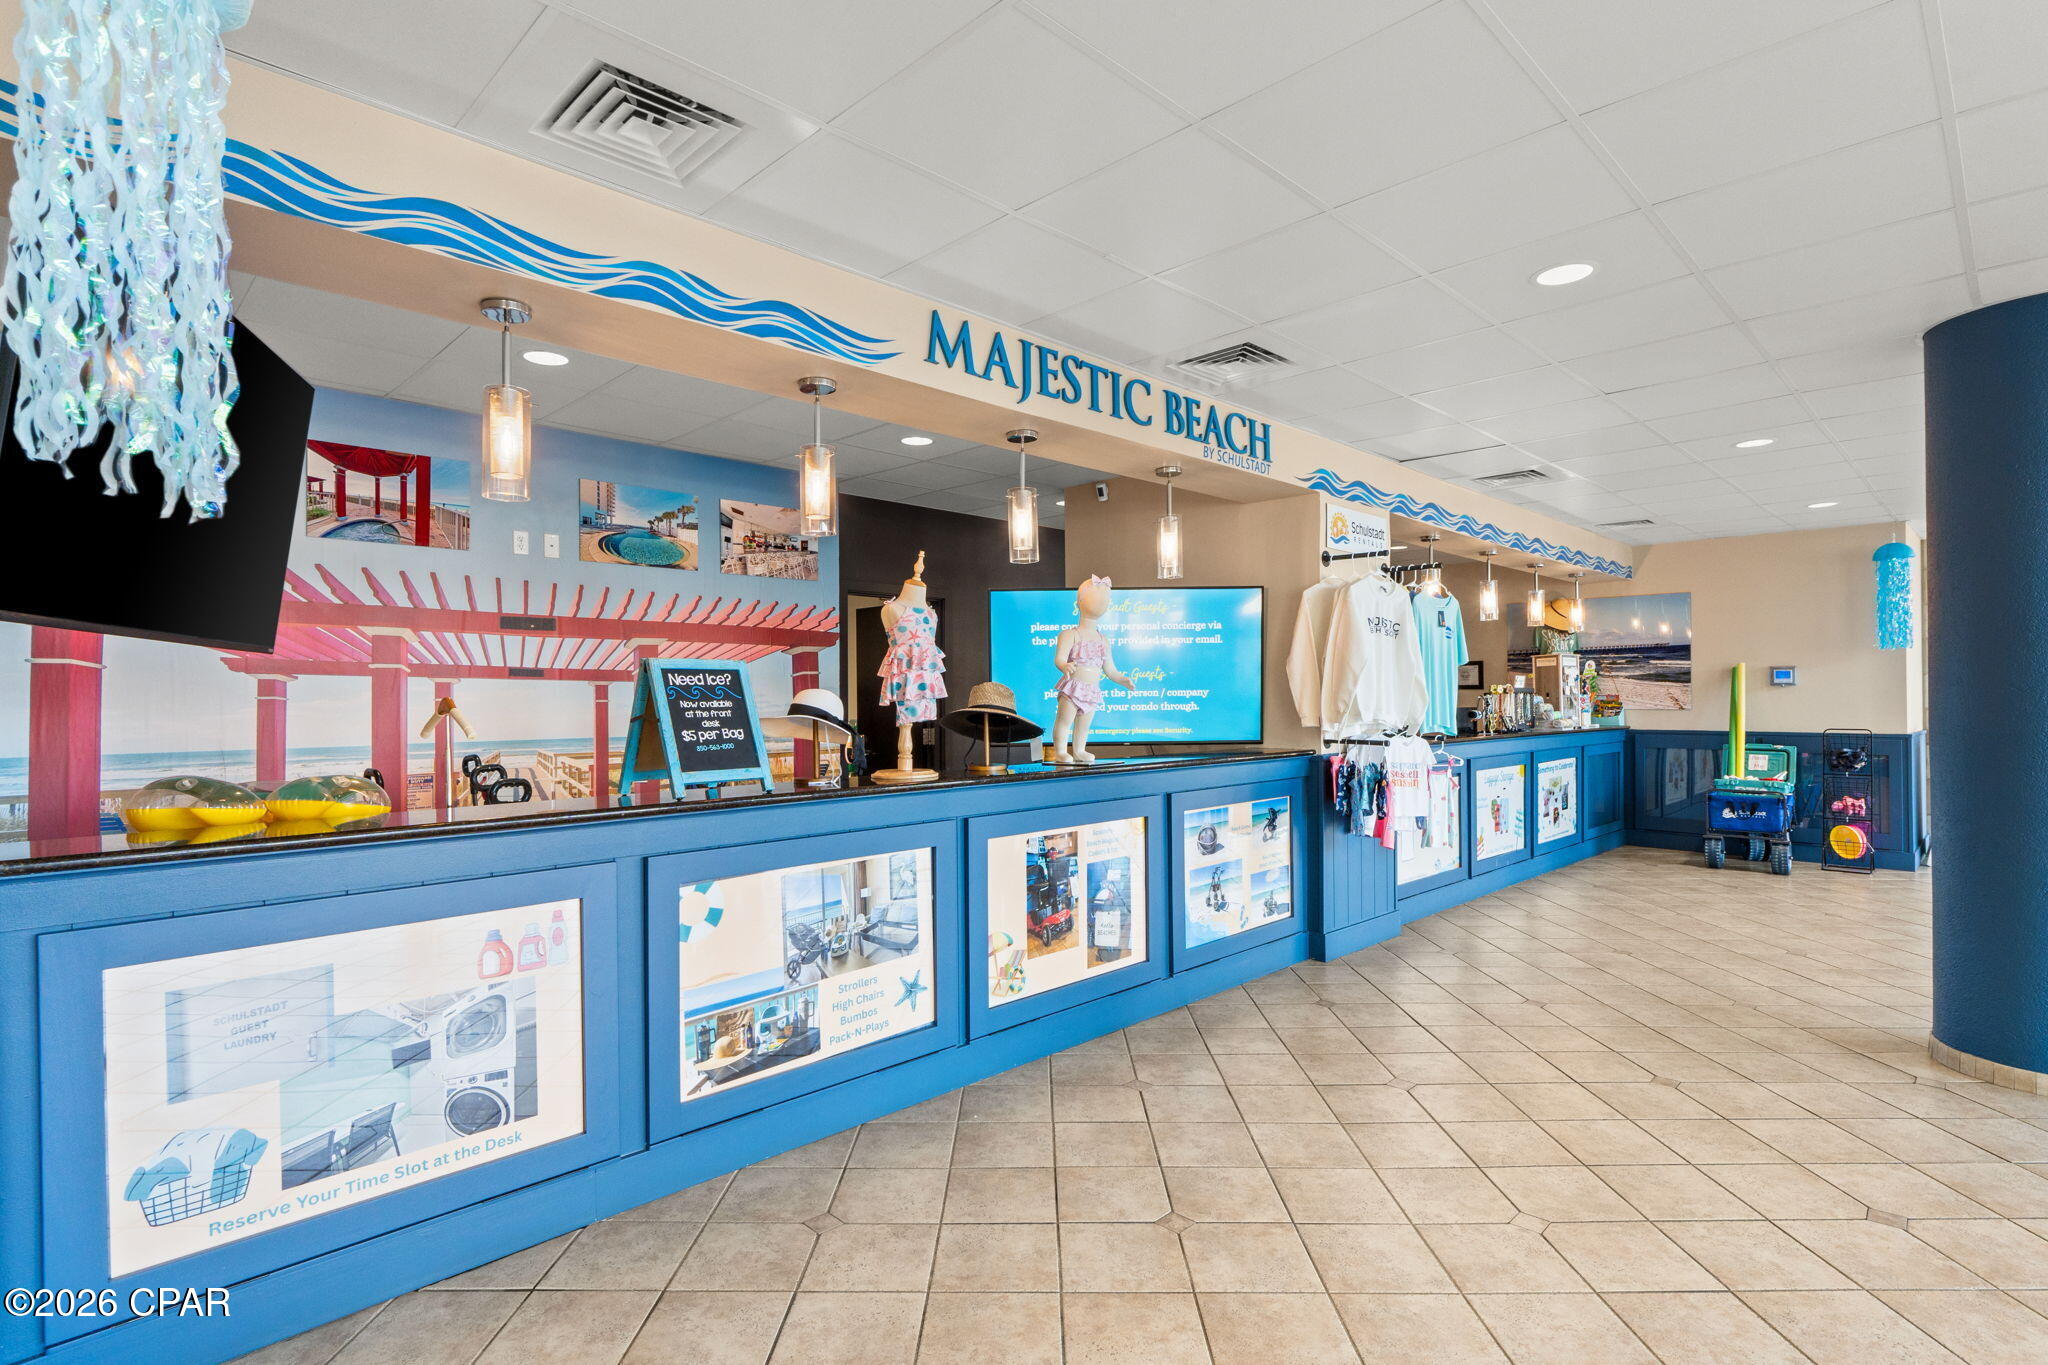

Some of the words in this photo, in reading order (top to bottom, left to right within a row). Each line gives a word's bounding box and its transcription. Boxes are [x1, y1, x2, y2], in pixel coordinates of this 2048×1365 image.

[924, 309, 1153, 428] MAJESTIC
[1162, 389, 1273, 463] BEACH
[1203, 445, 1214, 459] BY
[1217, 449, 1271, 475] SCHULSTADT
[1351, 521, 1385, 541] Schulstadt
[1030, 622, 1060, 634] please
[1096, 622, 1120, 632] your
[1162, 620, 1207, 632] concierge
[1208, 620, 1223, 629] via
[1032, 636, 1048, 646] the
[1161, 634, 1170, 643] in
[1171, 636, 1194, 646] your
[1195, 634, 1223, 644] email.
[667, 673, 705, 686] Need
[705, 673, 731, 686] Ice?
[1131, 665, 1166, 681] Guests
[1110, 688, 1126, 698] the
[1127, 689, 1159, 700] person
[1167, 689, 1209, 700] company
[680, 700, 698, 708] Now
[1106, 703, 1130, 713] your
[1131, 701, 1159, 711] condo
[1160, 700, 1200, 712] through.
[685, 710, 694, 718] at
[695, 710, 710, 718] the
[711, 710, 732, 718] front
[701, 720, 721, 728] desk
[681, 730, 697, 741] $5
[697, 730, 720, 743] per
[721, 728, 744, 740] Bag
[837, 976, 878, 994] Strollers
[832, 998, 854, 1012] High
[856, 989, 885, 1005] Chairs
[213, 1000, 288, 1026] SCHULSTADT
[840, 1007, 878, 1026] Bumbos
[231, 1019, 269, 1036] GUEST
[829, 1019, 889, 1046] Pack-N-Plays
[224, 1031, 277, 1050] LAUNDRY
[208, 1202, 291, 1237] Reserve
[296, 1185, 341, 1209] Your
[345, 1172, 390, 1195] Time
[394, 1160, 429, 1180] Slot
[433, 1155, 450, 1169] at
[454, 1142, 481, 1162] the
[485, 1130, 523, 1152] Desk
